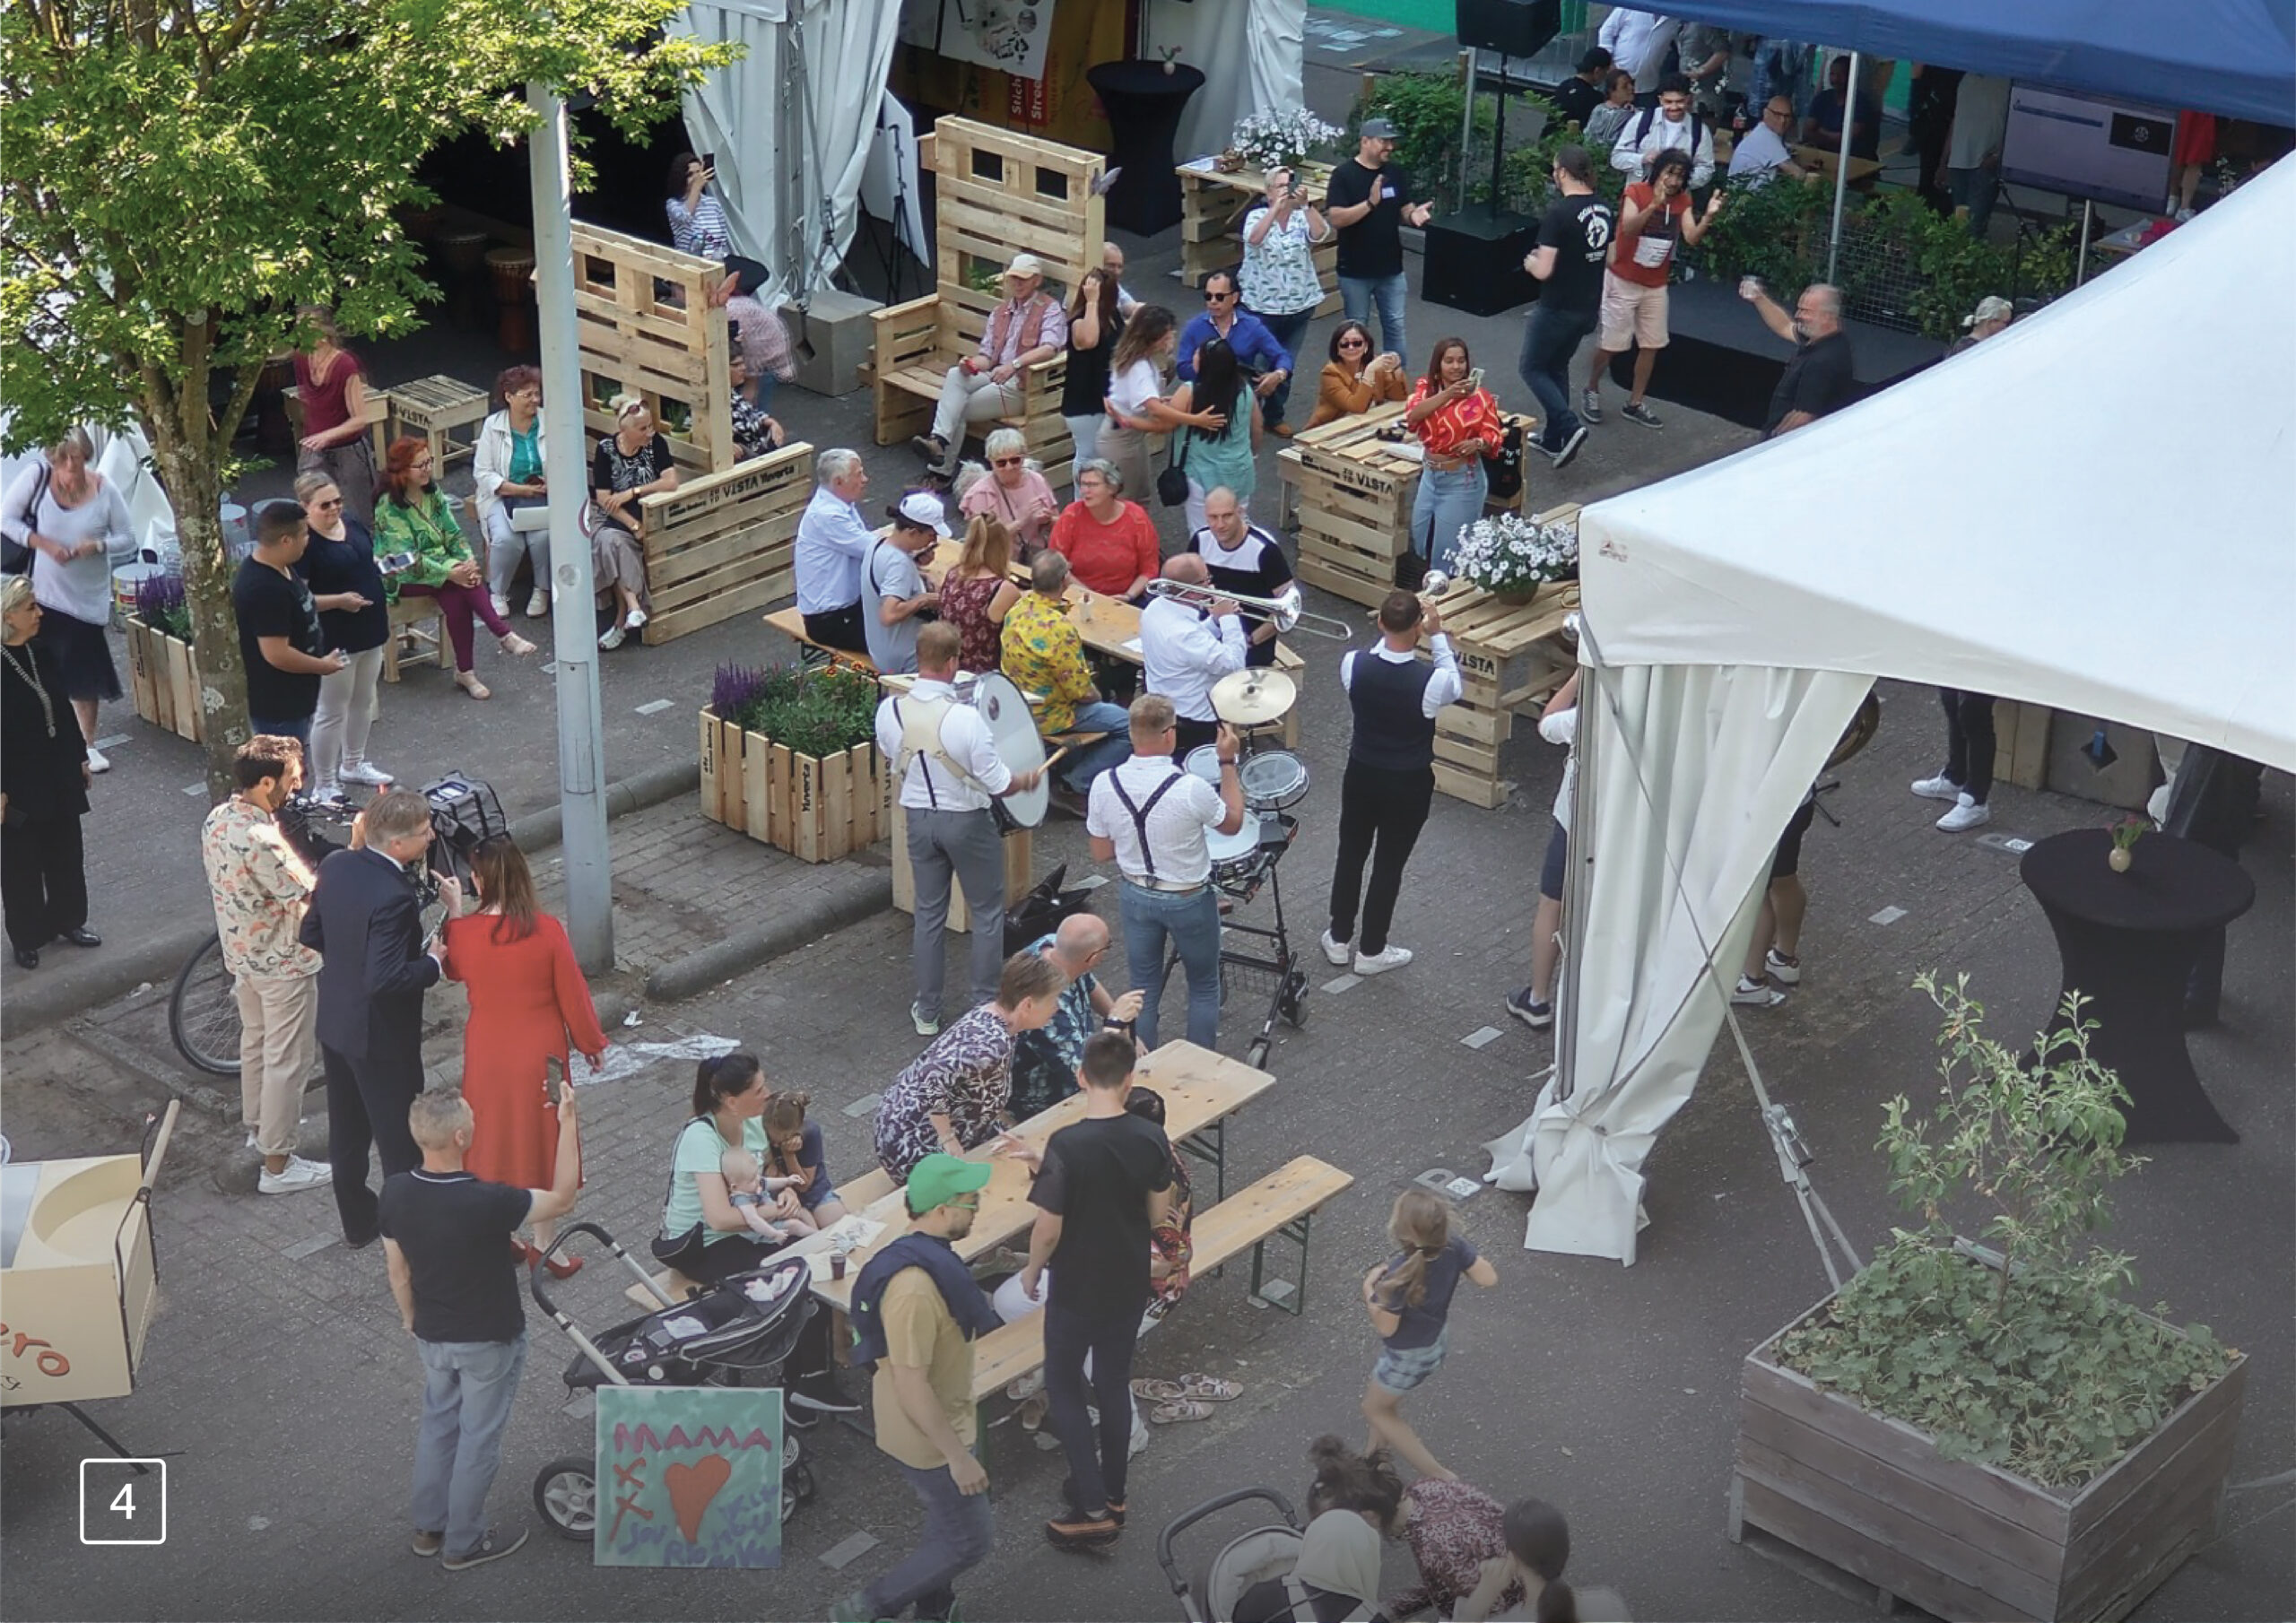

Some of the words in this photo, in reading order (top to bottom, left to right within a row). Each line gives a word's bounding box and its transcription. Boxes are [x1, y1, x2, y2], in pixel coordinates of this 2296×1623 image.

[1011, 77, 1022, 116] Stich
[1031, 79, 1043, 120] Stree
[723, 475, 759, 499] VISTA
[1357, 472, 1394, 495] VISTA
[613, 1422, 773, 1454] MAMA
